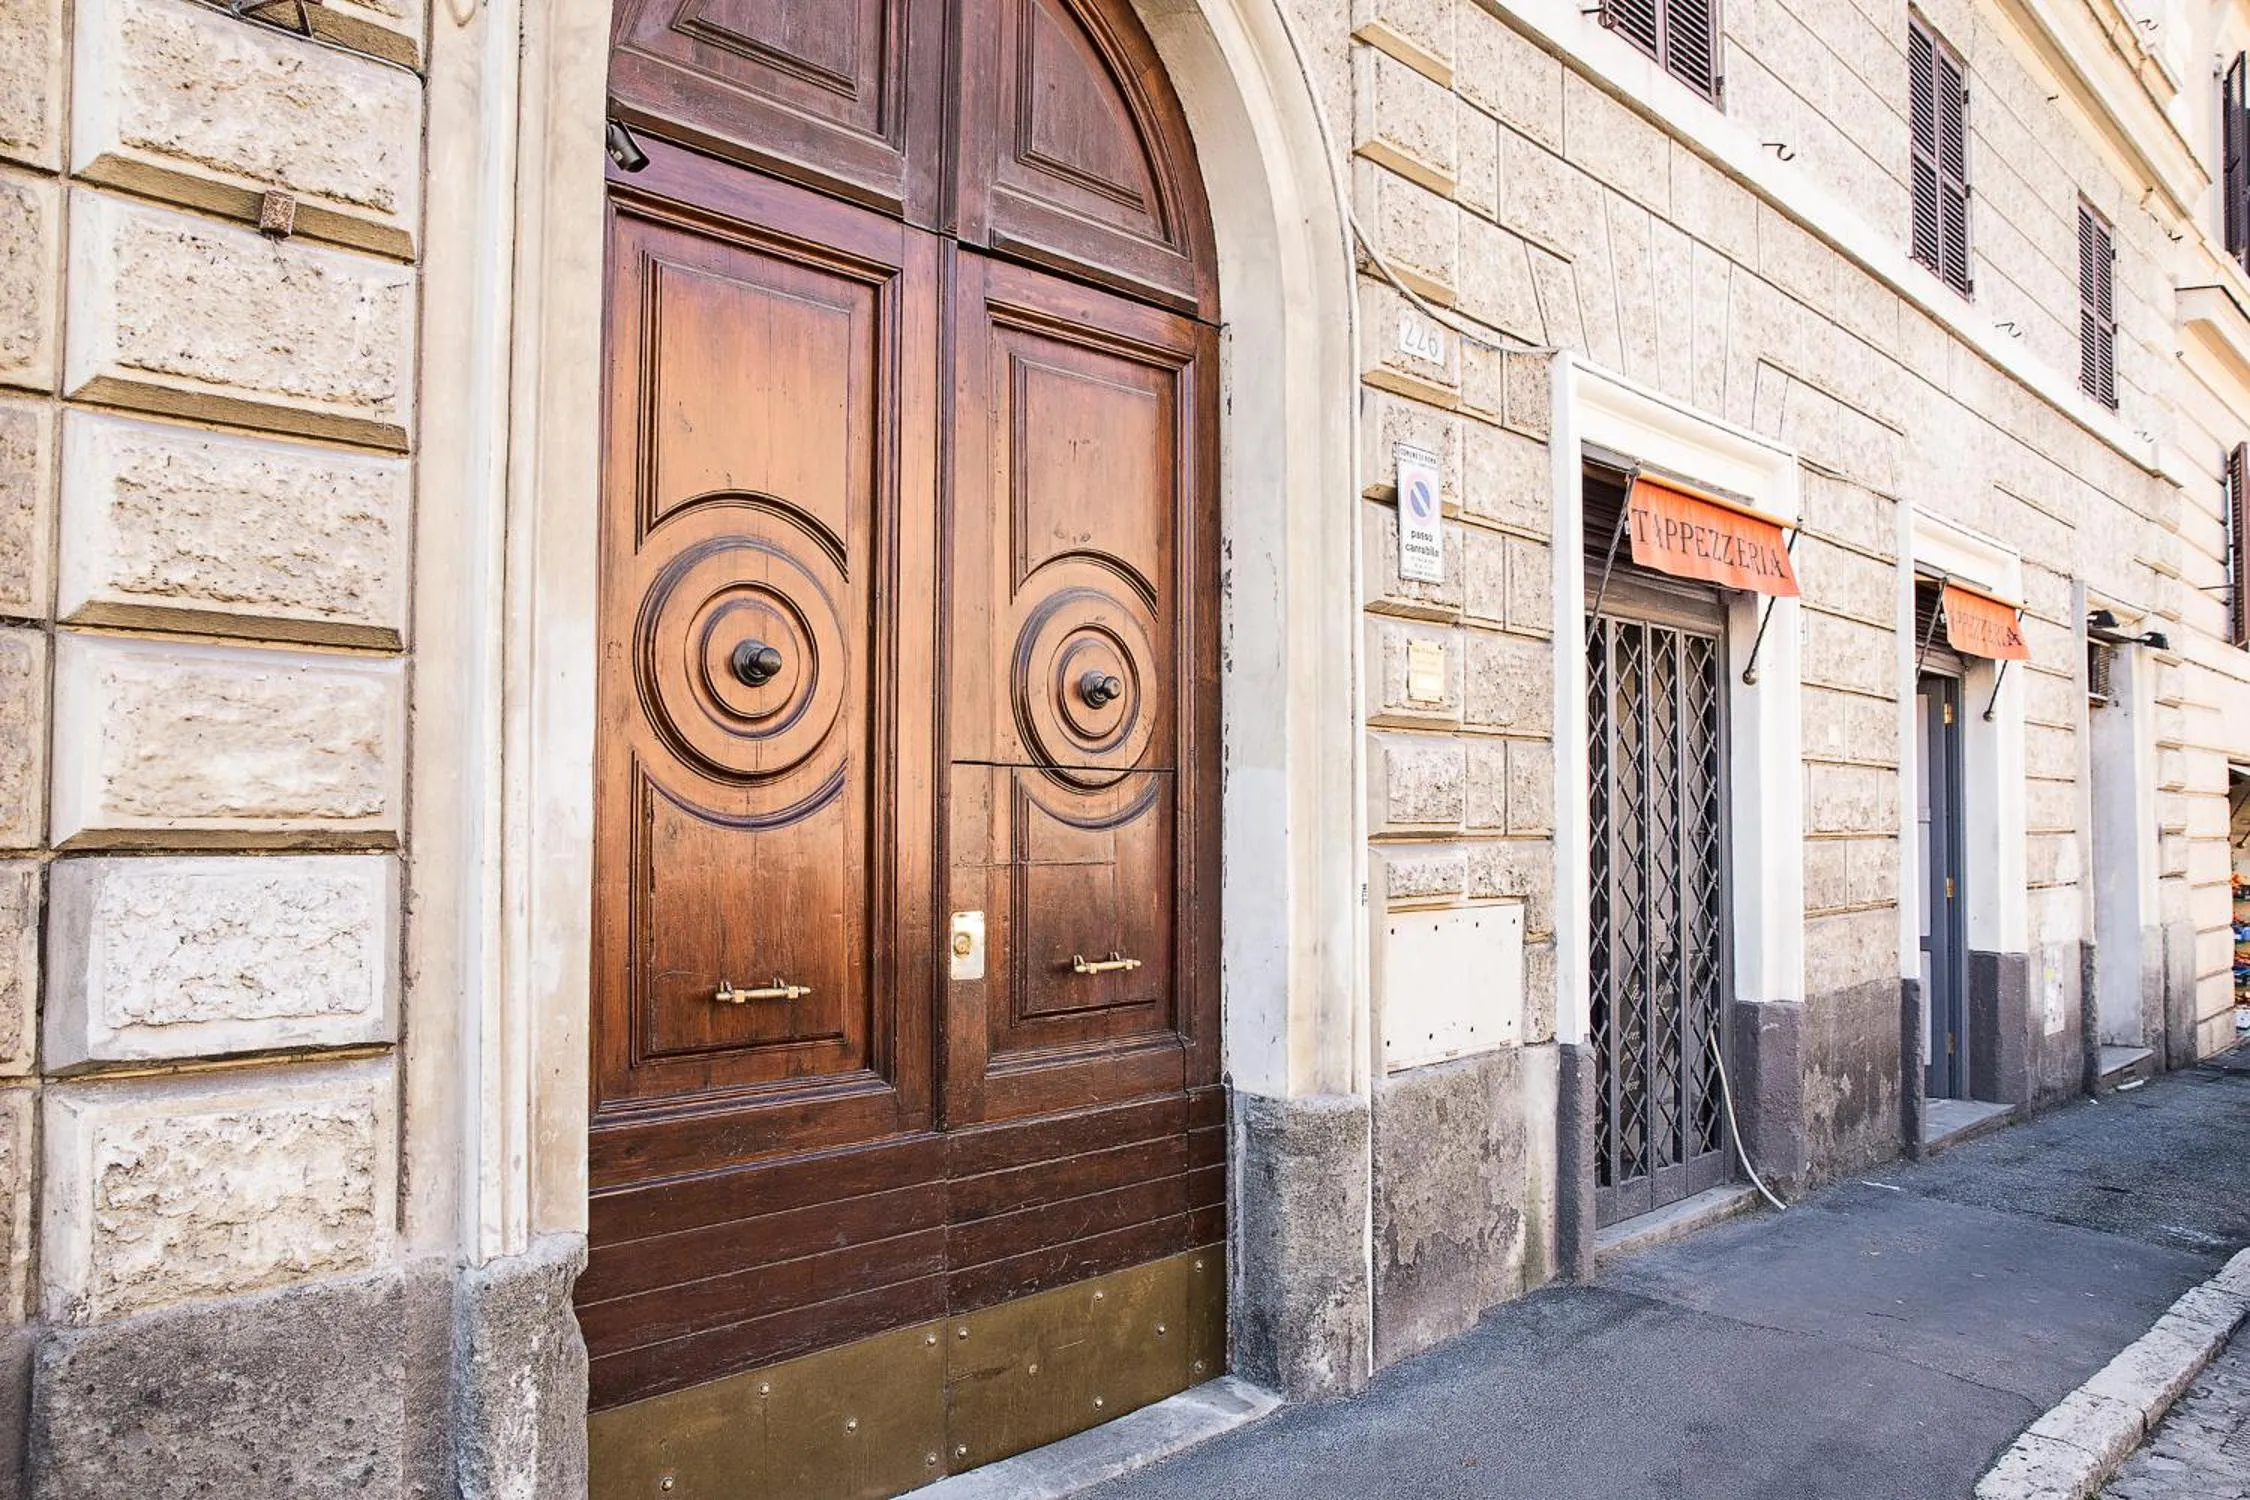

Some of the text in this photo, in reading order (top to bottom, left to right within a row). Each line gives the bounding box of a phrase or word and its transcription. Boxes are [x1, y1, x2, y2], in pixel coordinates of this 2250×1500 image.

[1404, 314, 1438, 358] 226
[1411, 530, 1433, 542] passo
[1631, 508, 1788, 579] TAPPEZZERIA
